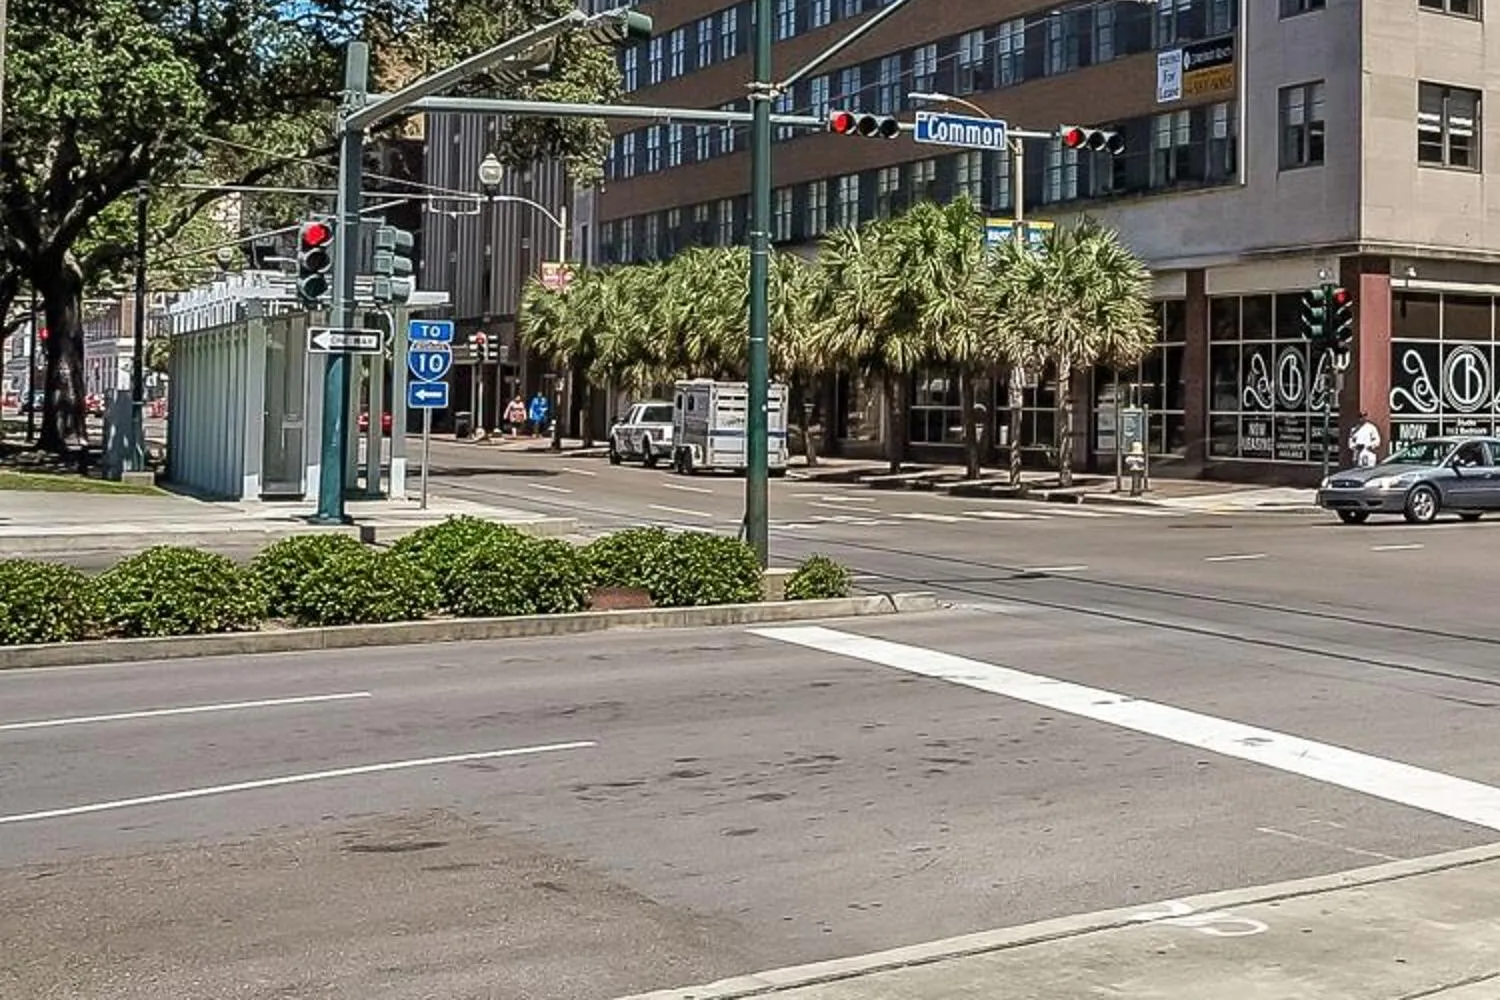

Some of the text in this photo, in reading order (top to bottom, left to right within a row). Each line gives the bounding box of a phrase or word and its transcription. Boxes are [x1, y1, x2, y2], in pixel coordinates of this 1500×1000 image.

[927, 117, 1003, 147] Common
[420, 325, 441, 338] TO
[419, 354, 443, 373] 10
[1400, 424, 1427, 439] NOW
